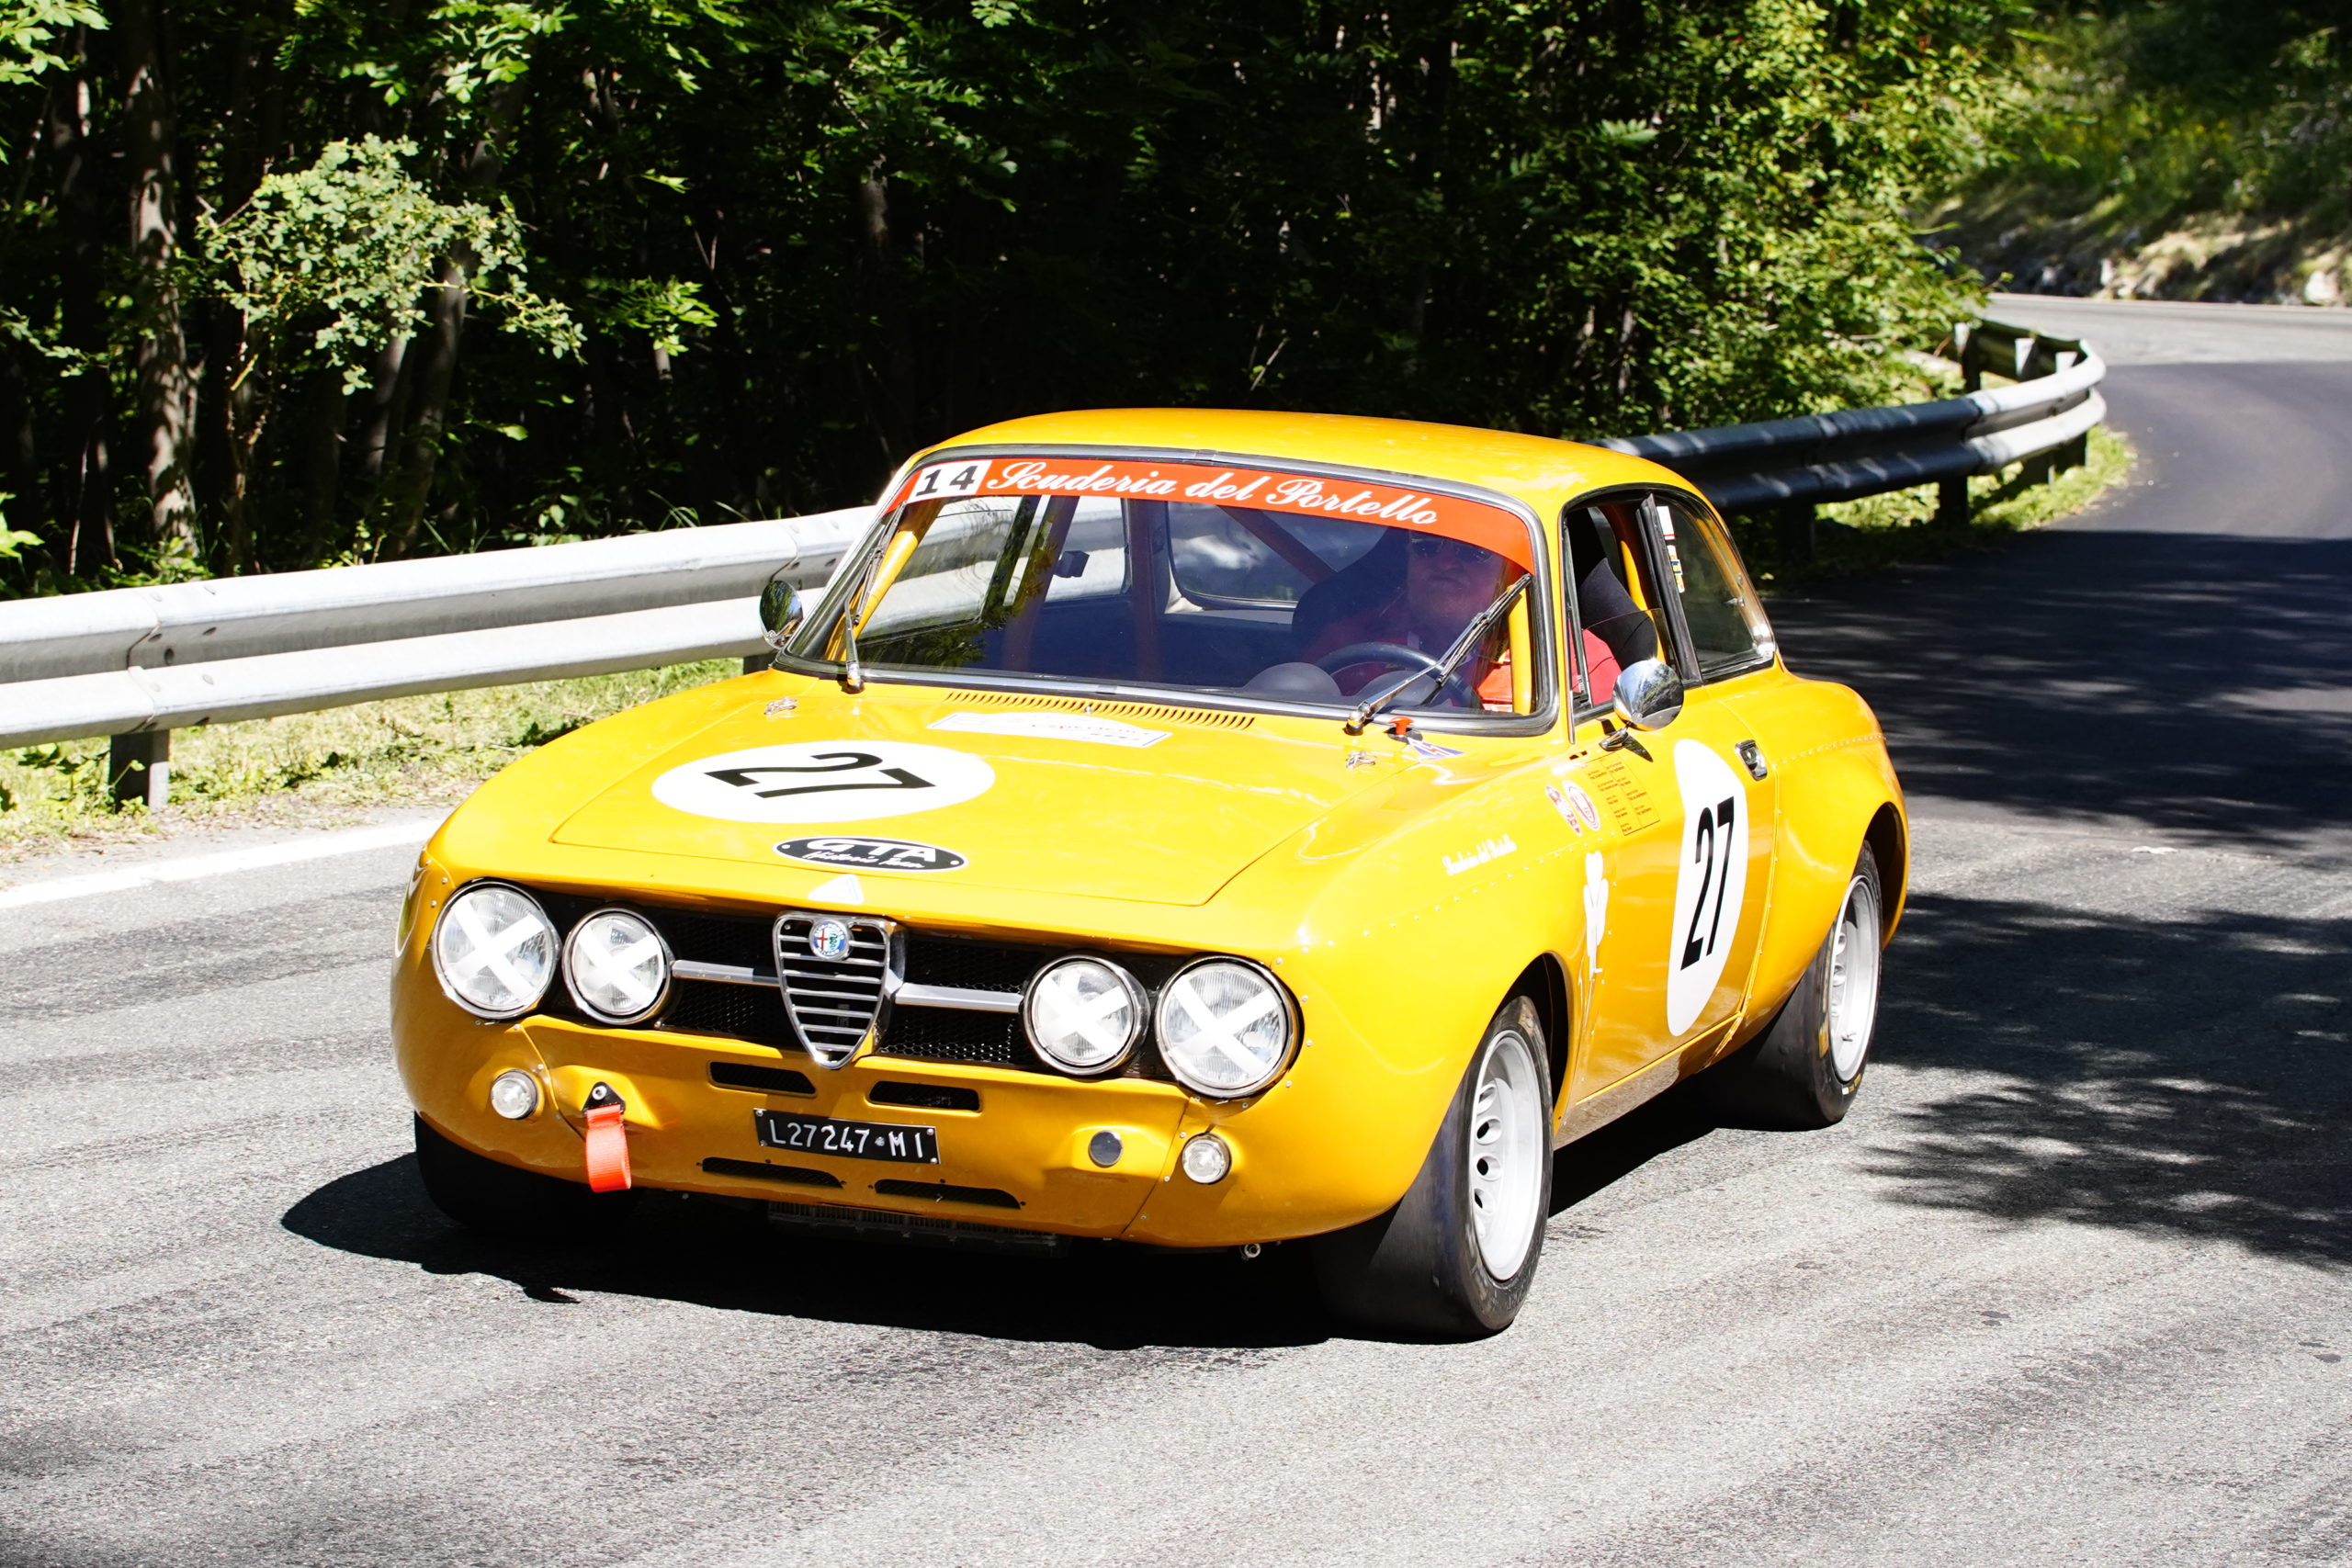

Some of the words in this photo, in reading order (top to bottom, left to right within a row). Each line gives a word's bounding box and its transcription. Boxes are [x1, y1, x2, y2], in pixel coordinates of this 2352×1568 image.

[916, 466, 978, 496] 14
[987, 461, 1178, 495] Scuderia
[1184, 472, 1253, 501] del
[1265, 479, 1437, 525] Portello
[704, 752, 936, 798] 27
[807, 839, 936, 863] GTA
[1680, 795, 1735, 971] 27
